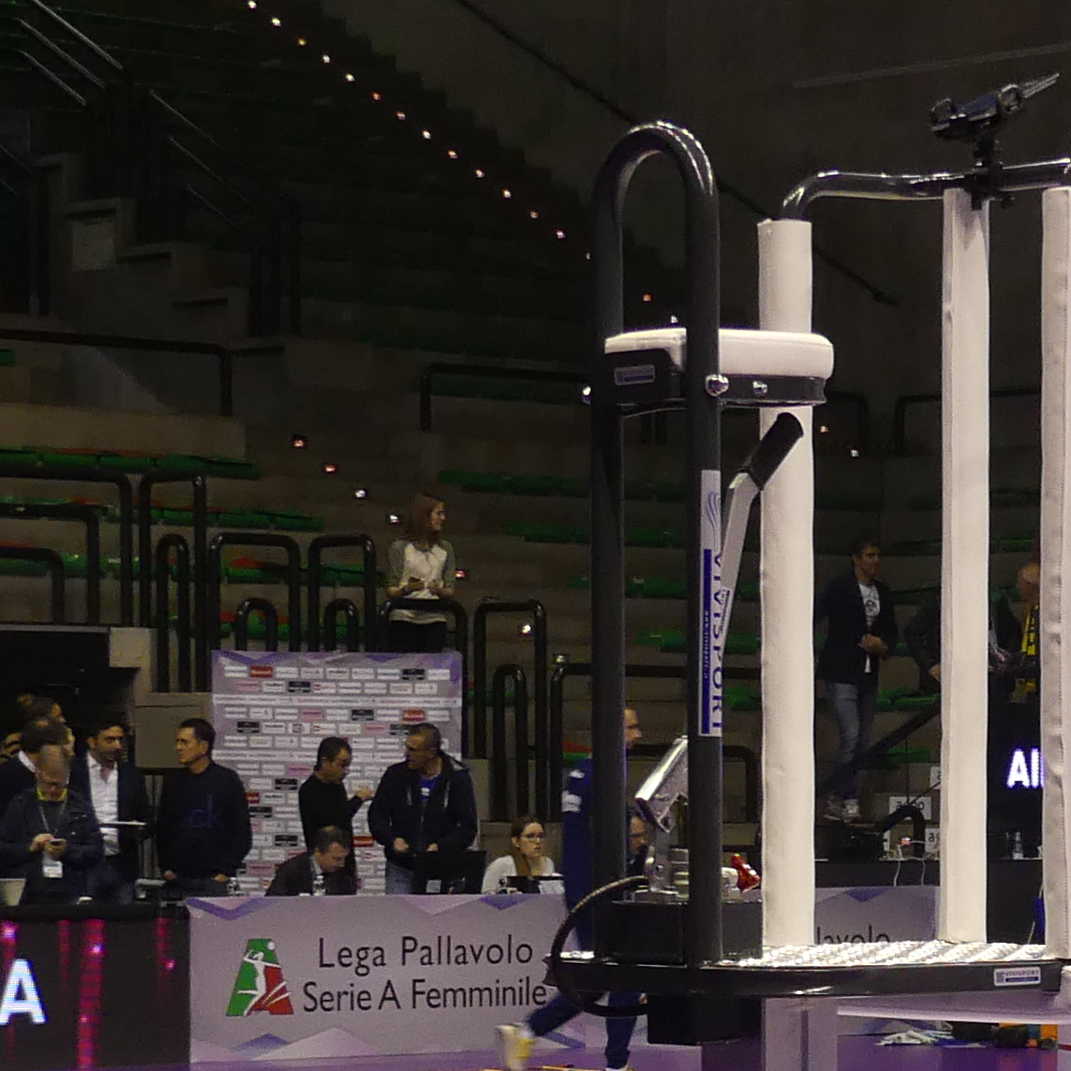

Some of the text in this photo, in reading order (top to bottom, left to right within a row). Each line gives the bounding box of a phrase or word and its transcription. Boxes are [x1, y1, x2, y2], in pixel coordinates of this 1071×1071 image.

[319, 934, 533, 977] Lega Pallavolo
[0, 958, 46, 1025] A
[302, 976, 548, 1012] Serie A Femminile
